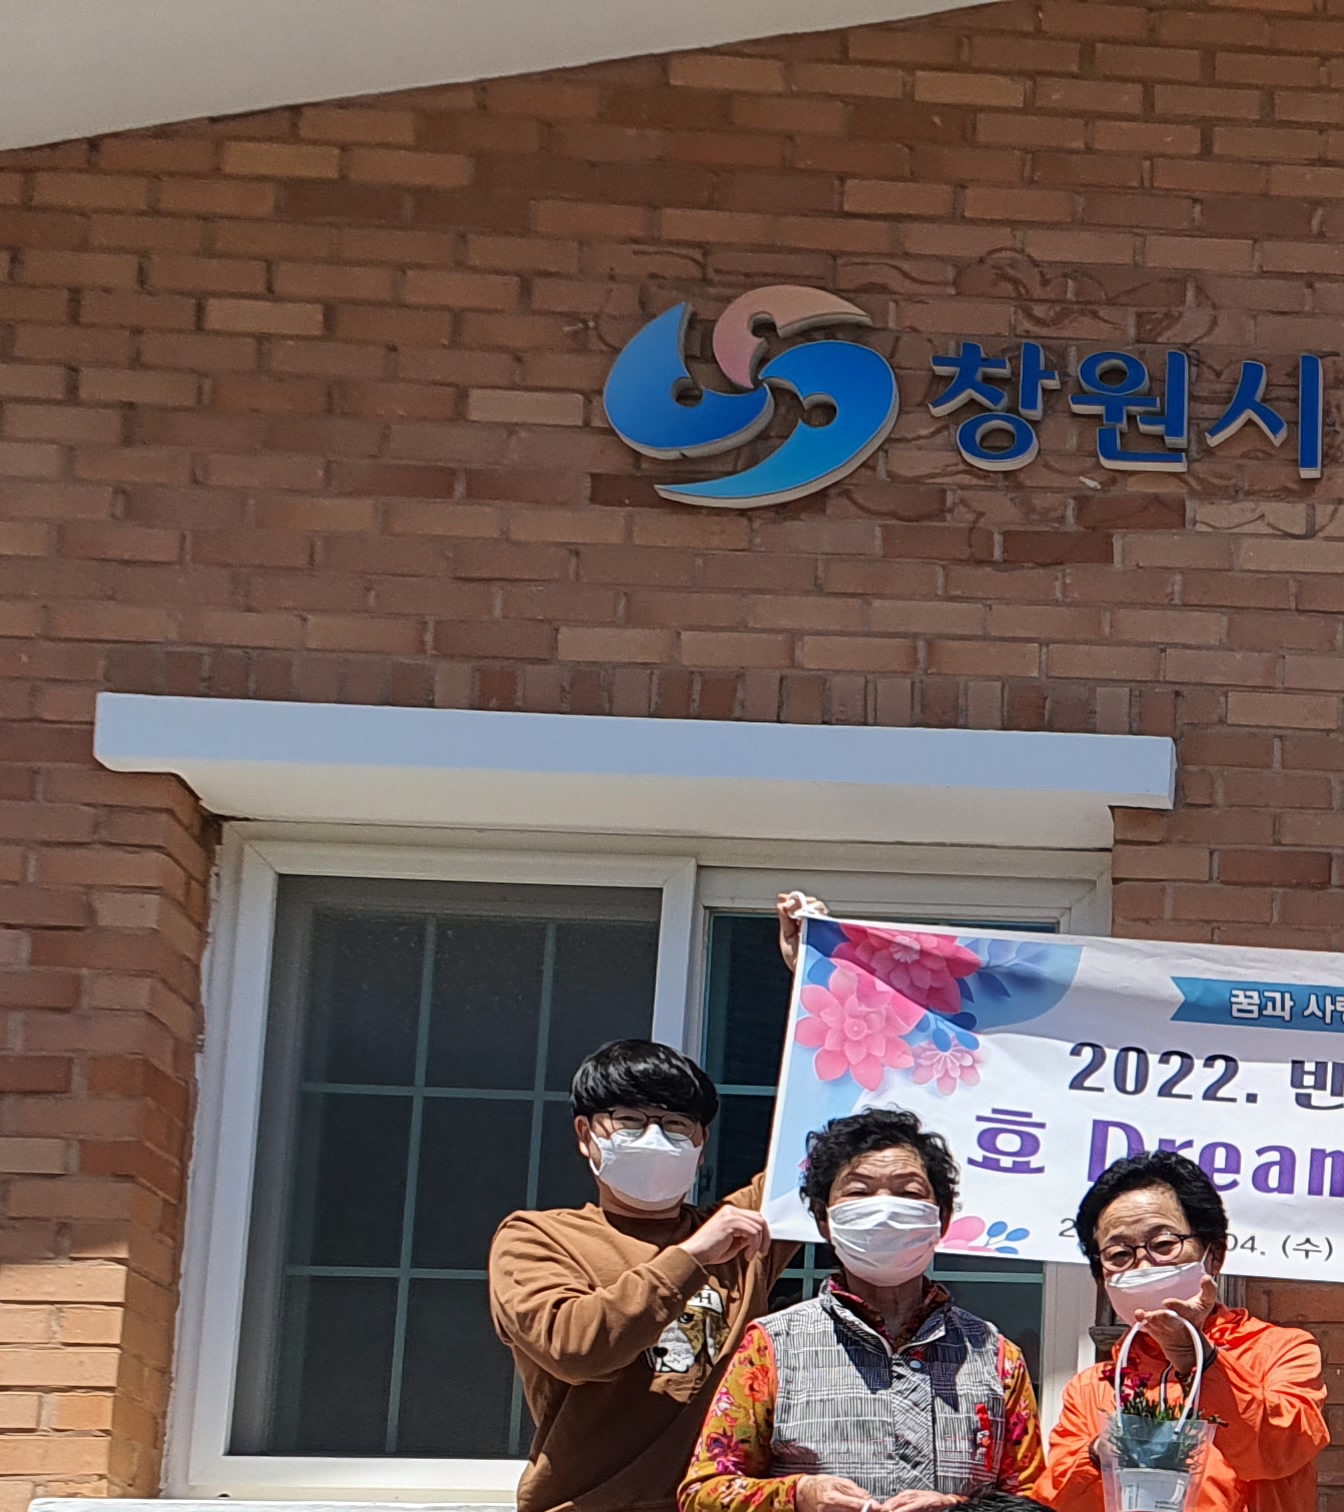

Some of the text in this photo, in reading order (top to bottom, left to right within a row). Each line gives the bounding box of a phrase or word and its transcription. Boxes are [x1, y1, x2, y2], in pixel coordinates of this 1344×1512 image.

[928, 340, 1324, 479] 창원시
[1230, 989, 1295, 1021] 꿈과
[1069, 1042, 1258, 1104] 2022.
[966, 1108, 1047, 1175] 효
[1281, 1234, 1334, 1261] (수)
